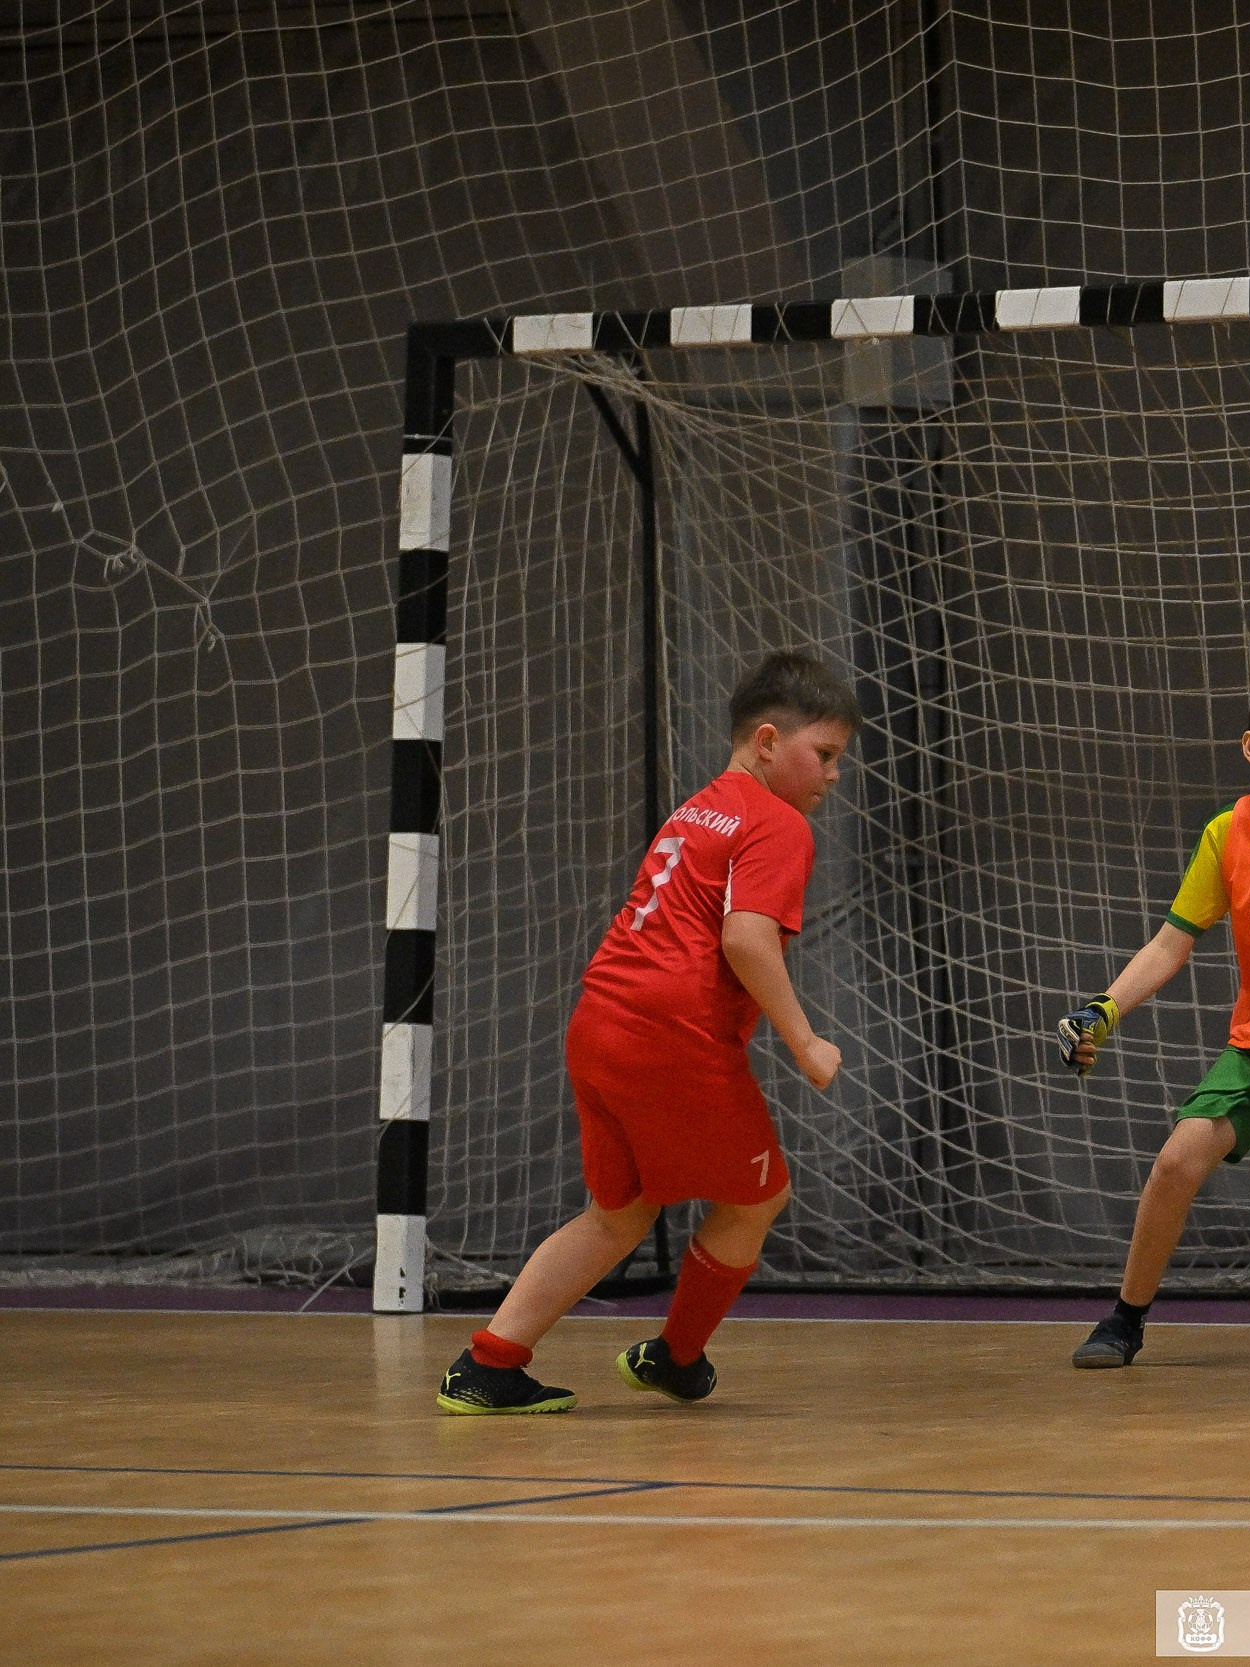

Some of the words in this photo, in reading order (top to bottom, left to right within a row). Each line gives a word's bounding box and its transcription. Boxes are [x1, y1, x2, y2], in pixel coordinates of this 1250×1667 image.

[667, 806, 741, 837] ОЛЬСКИЙ
[630, 837, 686, 932] 7
[750, 1150, 770, 1187] 7
